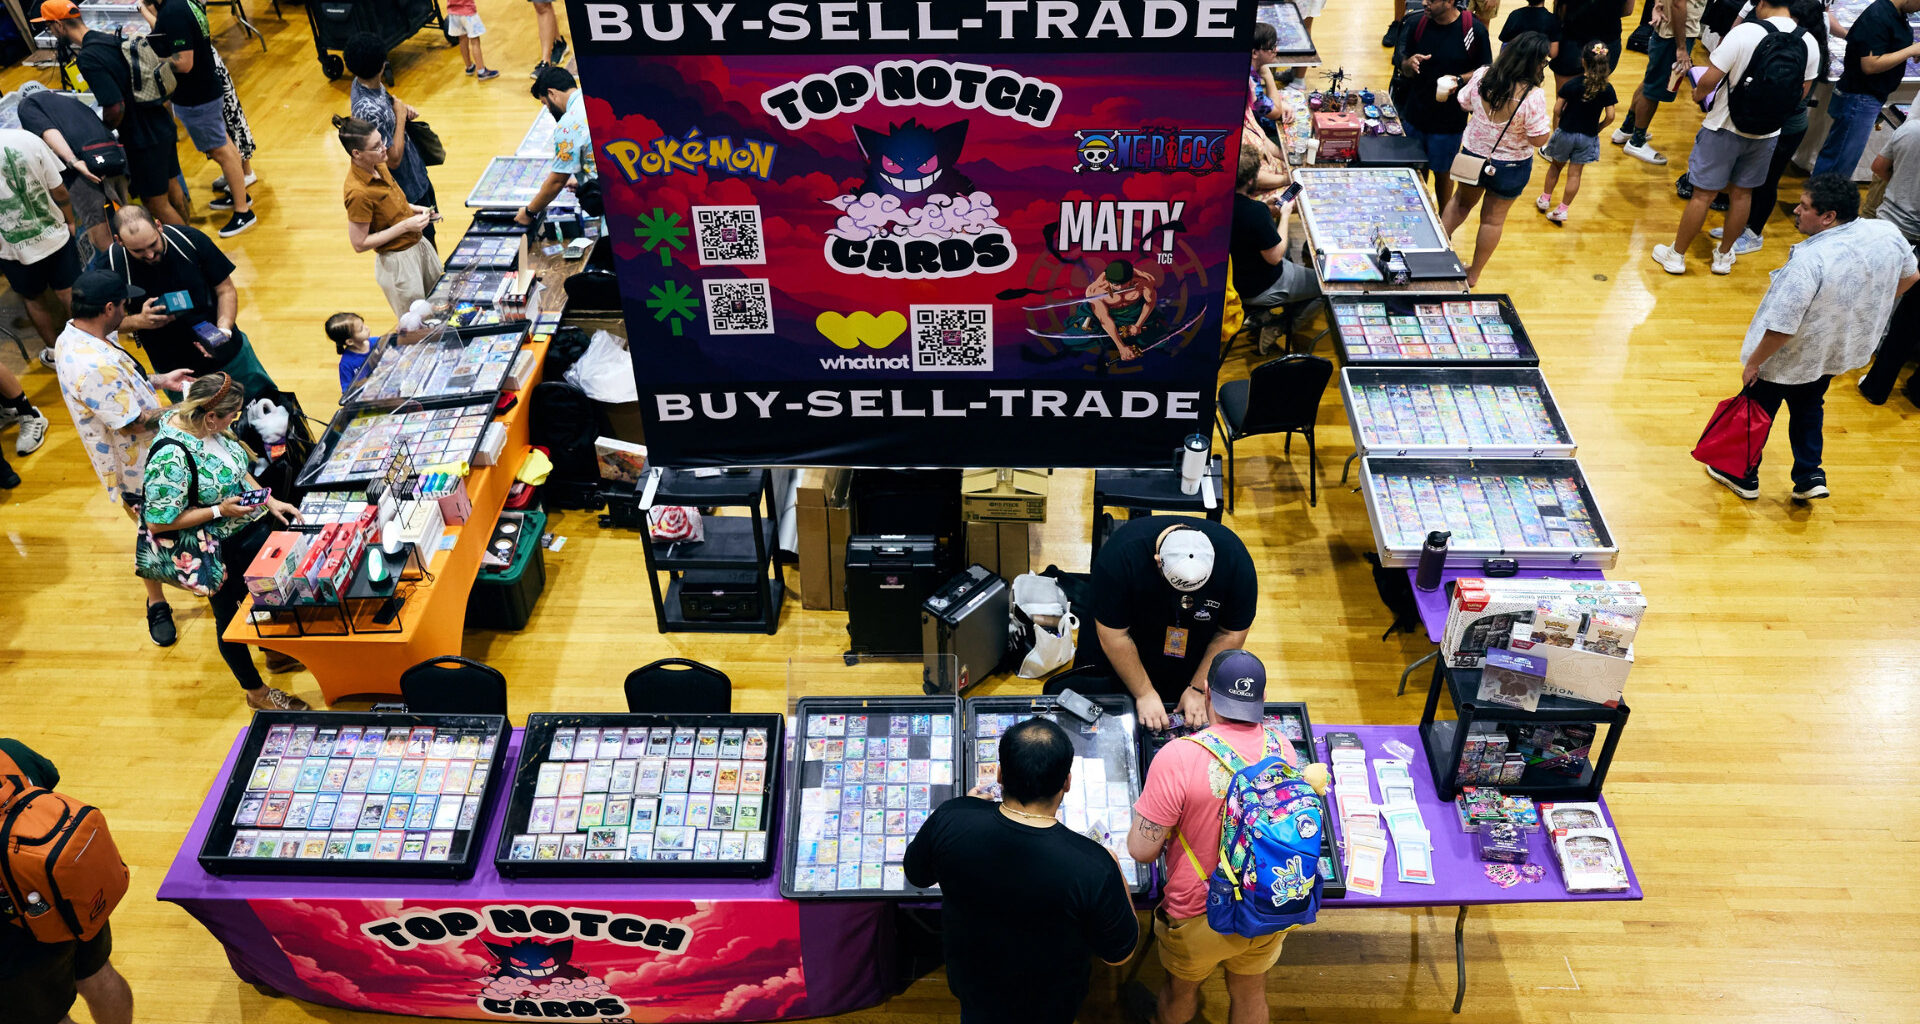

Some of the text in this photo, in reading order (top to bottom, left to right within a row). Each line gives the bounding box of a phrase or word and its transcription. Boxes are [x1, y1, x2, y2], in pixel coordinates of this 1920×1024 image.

[584, 0, 1237, 41] BUY-SELL-TRADE
[767, 65, 1056, 124] TOP NOTCH
[1059, 200, 1185, 251] MATTY
[832, 234, 1010, 273] CARDS
[1157, 253, 1173, 265] TCG
[819, 354, 910, 370] whatnot
[654, 389, 1200, 422] BUY-SELL-TRADE
[368, 908, 687, 951] TOP NOTCH
[482, 998, 625, 1017] CARDS
